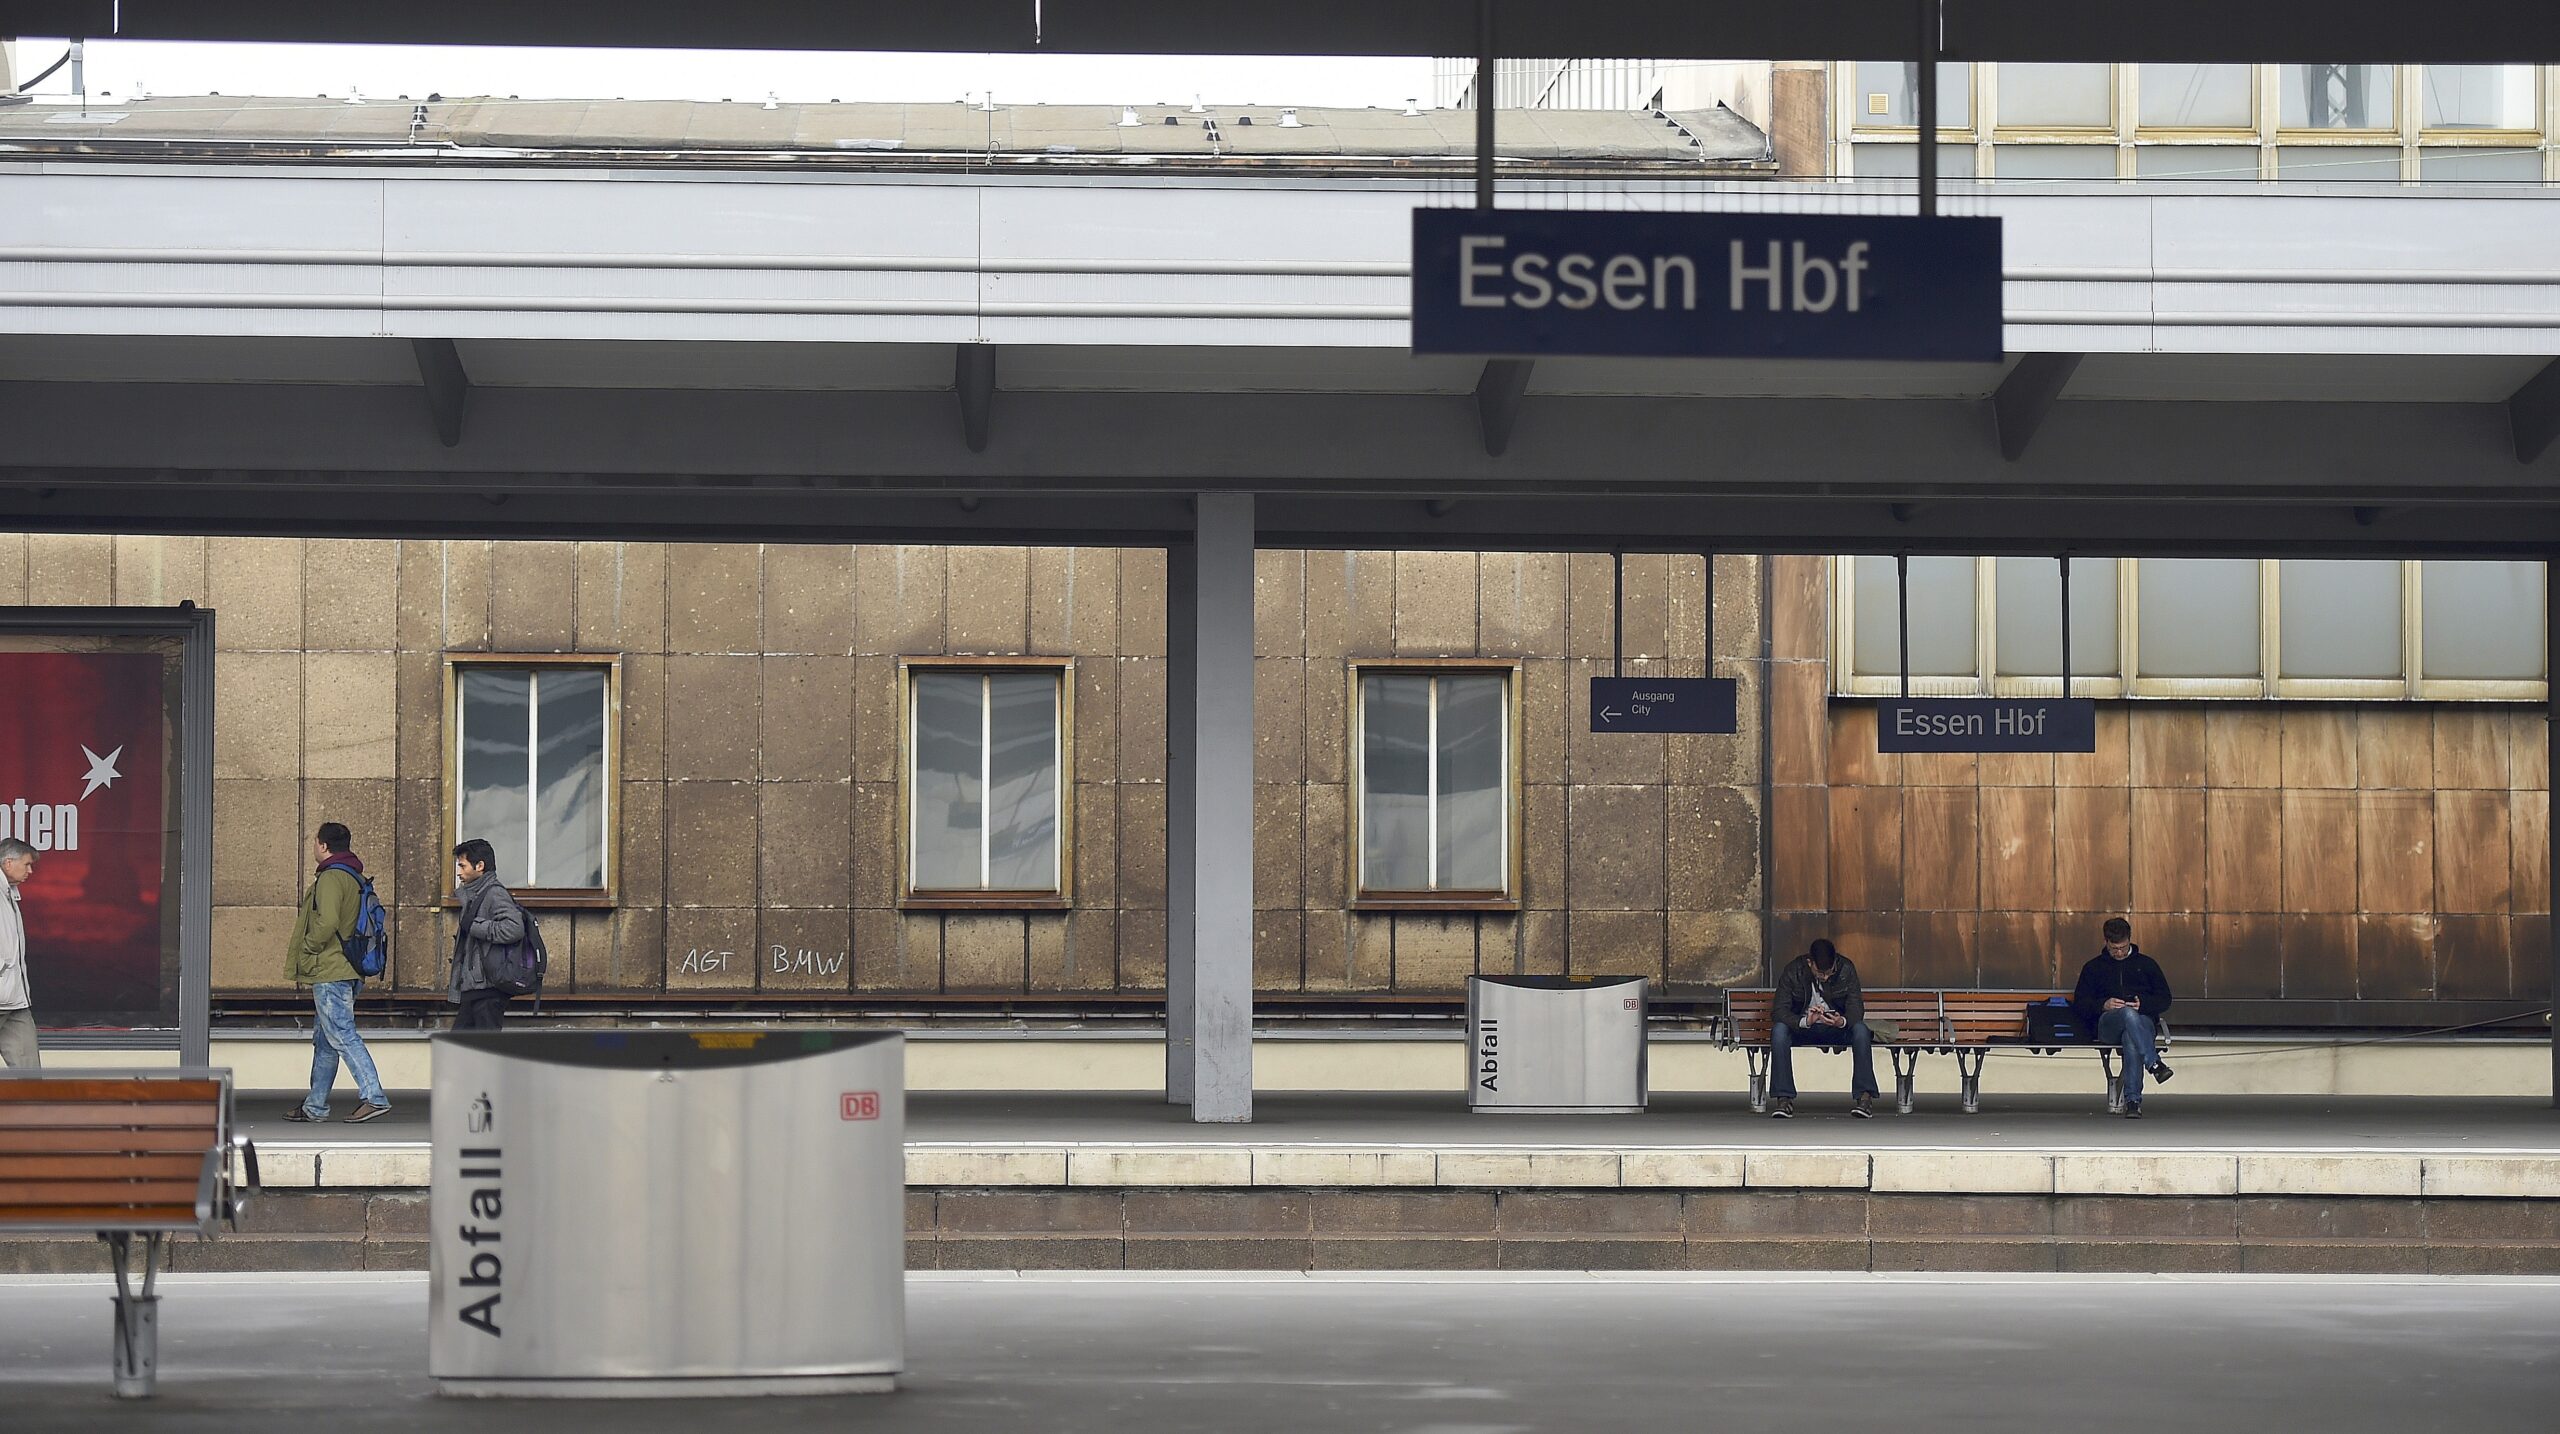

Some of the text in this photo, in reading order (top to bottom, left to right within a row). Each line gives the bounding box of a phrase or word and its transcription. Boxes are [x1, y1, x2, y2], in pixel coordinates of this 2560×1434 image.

[1459, 236, 1870, 313] Essen Hbf
[1631, 690, 1675, 703] Ausgang
[1631, 704, 1651, 716] City
[1896, 707, 2046, 736] Essen Hbf
[680, 944, 845, 976] AGT BMW
[1625, 1000, 1637, 1009] DB
[1480, 1019, 1498, 1092] Abfall
[844, 1095, 875, 1117] DB
[459, 1147, 502, 1338] Abfall
